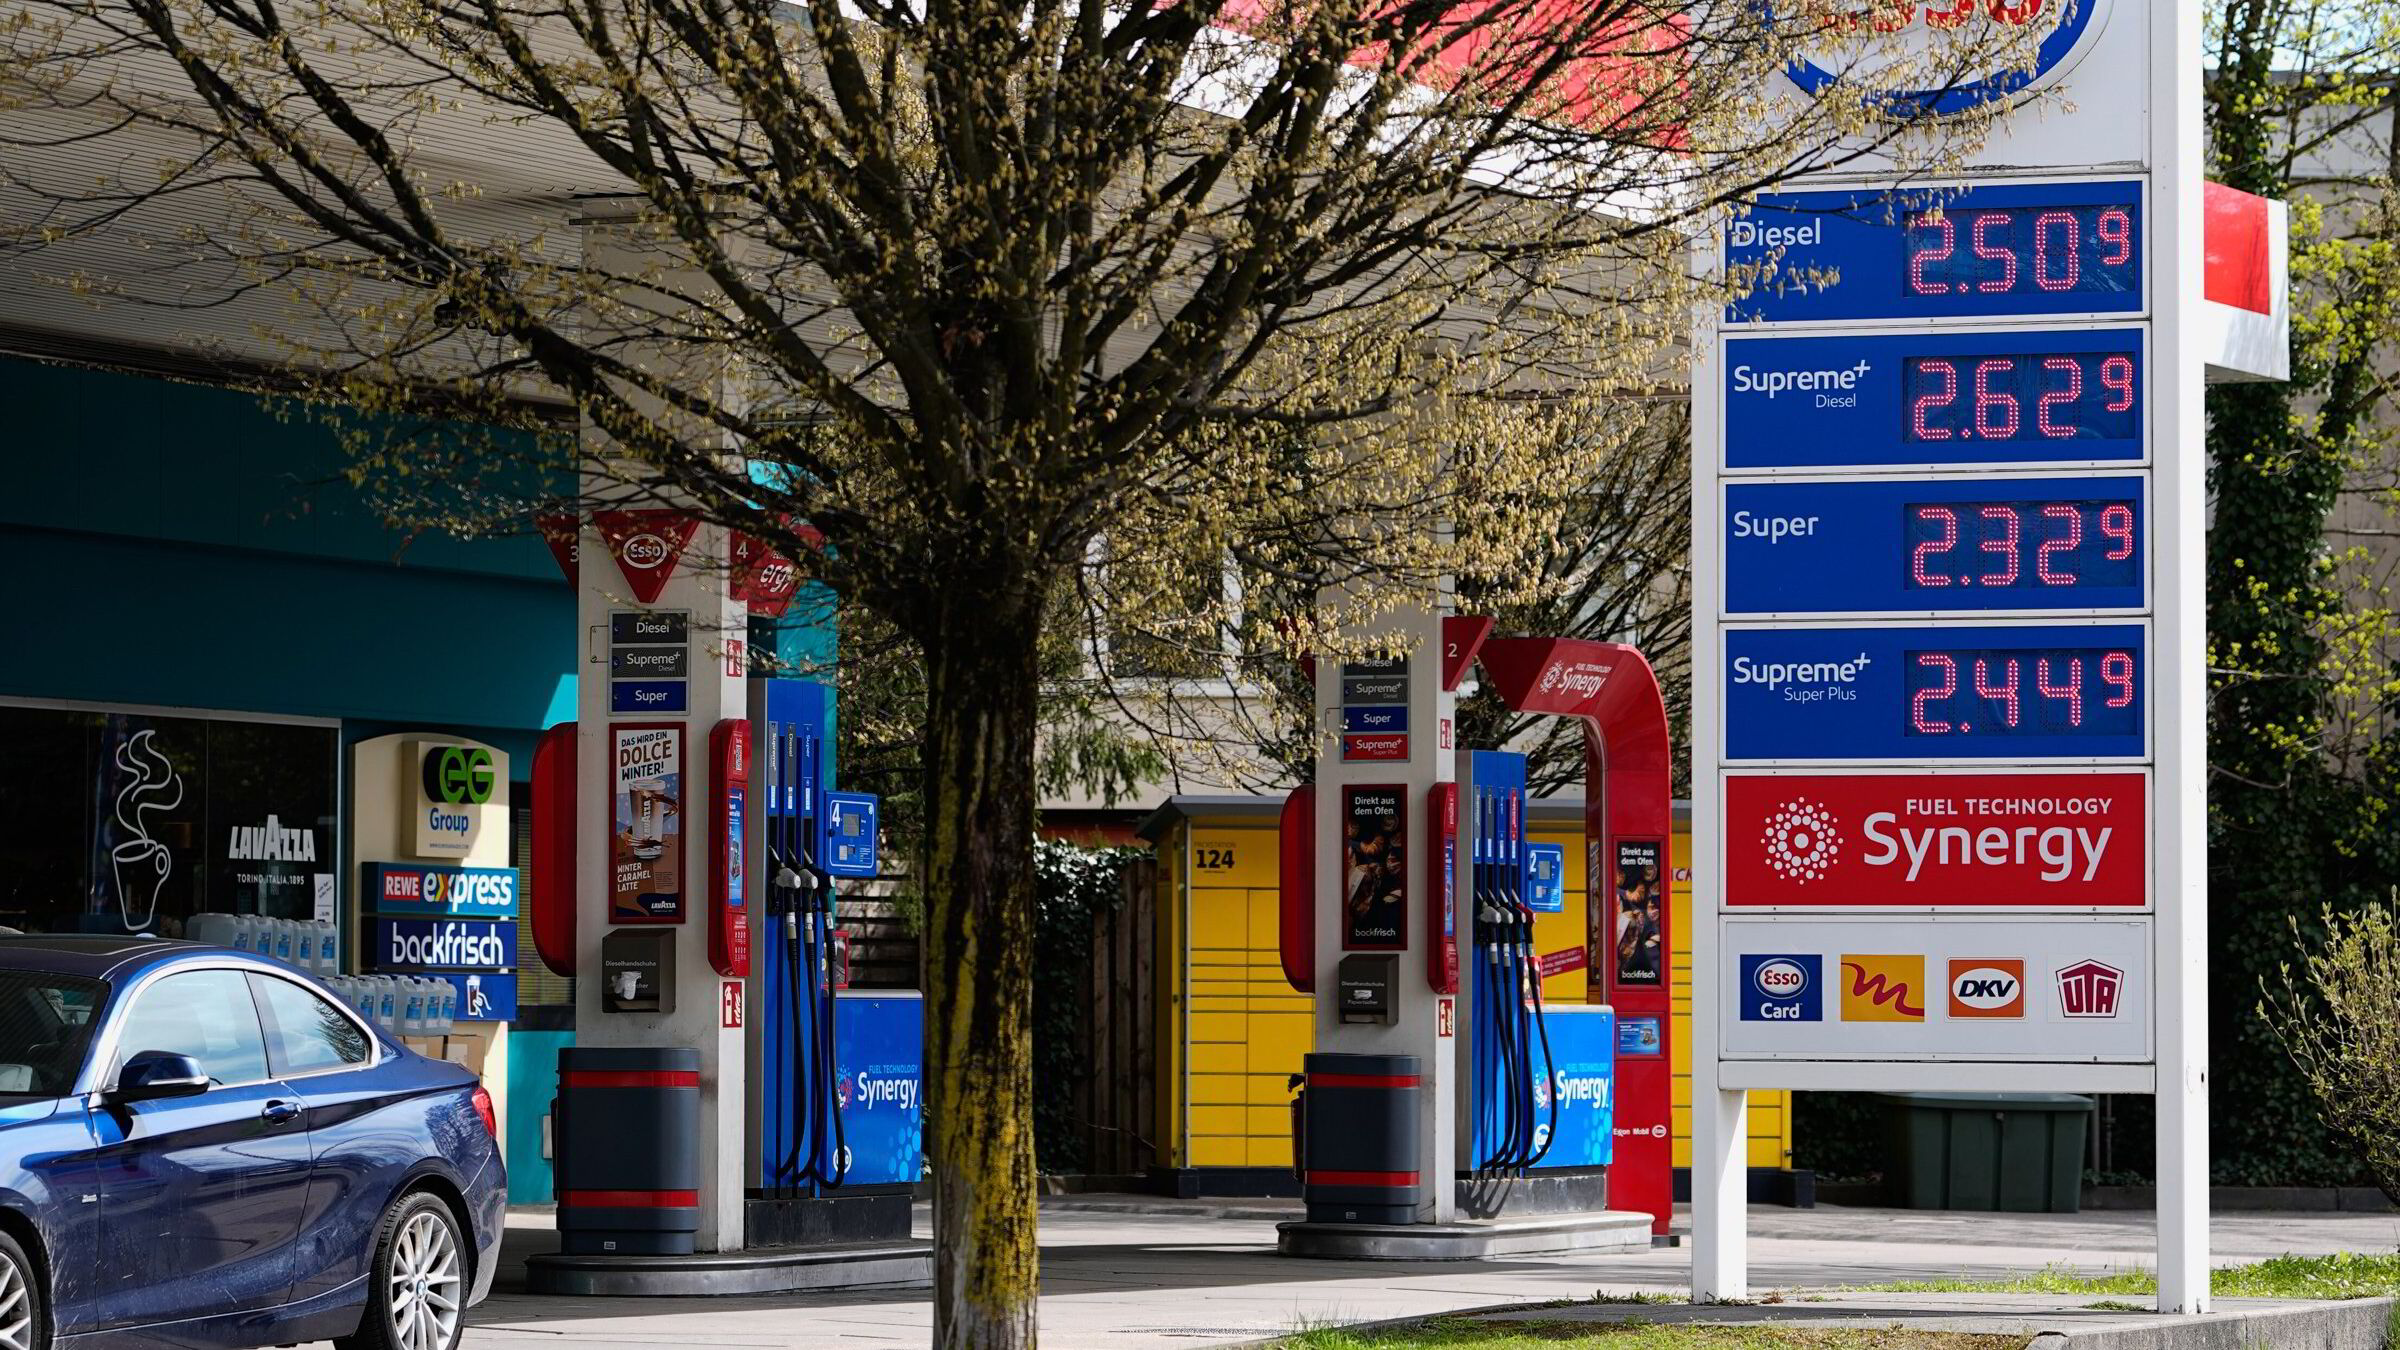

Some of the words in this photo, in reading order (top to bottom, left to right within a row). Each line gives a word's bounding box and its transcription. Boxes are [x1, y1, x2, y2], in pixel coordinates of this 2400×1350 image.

[1733, 217, 1821, 248] Diesel
[1815, 394, 1857, 408] Diesel
[1733, 511, 1819, 544] Super
[630, 543, 660, 557] Esso
[736, 541, 748, 559] 4
[636, 621, 670, 634] Diesel
[1448, 643, 1458, 658] 2
[658, 664, 676, 672] Diesel
[1557, 667, 1607, 698] Synergy
[635, 690, 668, 704] Super
[1784, 687, 1826, 704] Super
[1827, 687, 1857, 702] Plus
[1363, 713, 1391, 725] Super
[621, 736, 636, 748] DAS
[636, 733, 654, 745] WIRD
[655, 731, 667, 741] EIN
[620, 740, 672, 767] DOLCE
[622, 761, 665, 781] WINTER!
[1354, 796, 1379, 805] Direkt
[1906, 799, 1958, 815] FUEL
[1965, 798, 2112, 815] TECHNOLOGY
[832, 803, 841, 827] 4
[1354, 806, 1373, 815] dem
[1374, 806, 1394, 815] Ofen
[429, 807, 469, 837] Group
[228, 814, 316, 862] LAVAZZA
[1621, 847, 1641, 856] Direkt
[1863, 812, 2113, 882] Synergy
[1196, 849, 1235, 869] 124
[1529, 852, 1537, 873] 2
[1621, 857, 1637, 865] dem
[1637, 857, 1654, 865] Ofen
[617, 862, 642, 874] WINTER
[617, 870, 652, 883] CARAMEL
[385, 875, 420, 897] REWE
[423, 872, 513, 912] express
[617, 882, 639, 892] LATTE
[1355, 927, 1396, 937] backfrisch
[392, 921, 504, 965] backfrisch
[1622, 970, 1656, 979] backfrisch
[1763, 970, 1800, 987] Esso
[1958, 979, 2016, 997] DKV
[2061, 963, 2118, 1013] UTA
[1760, 1001, 1801, 1019] Card
[868, 1065, 882, 1074] FUEL
[883, 1064, 918, 1074] TECHNOLOGY
[857, 1071, 918, 1110] Synergy
[1556, 1070, 1609, 1109] Synergy
